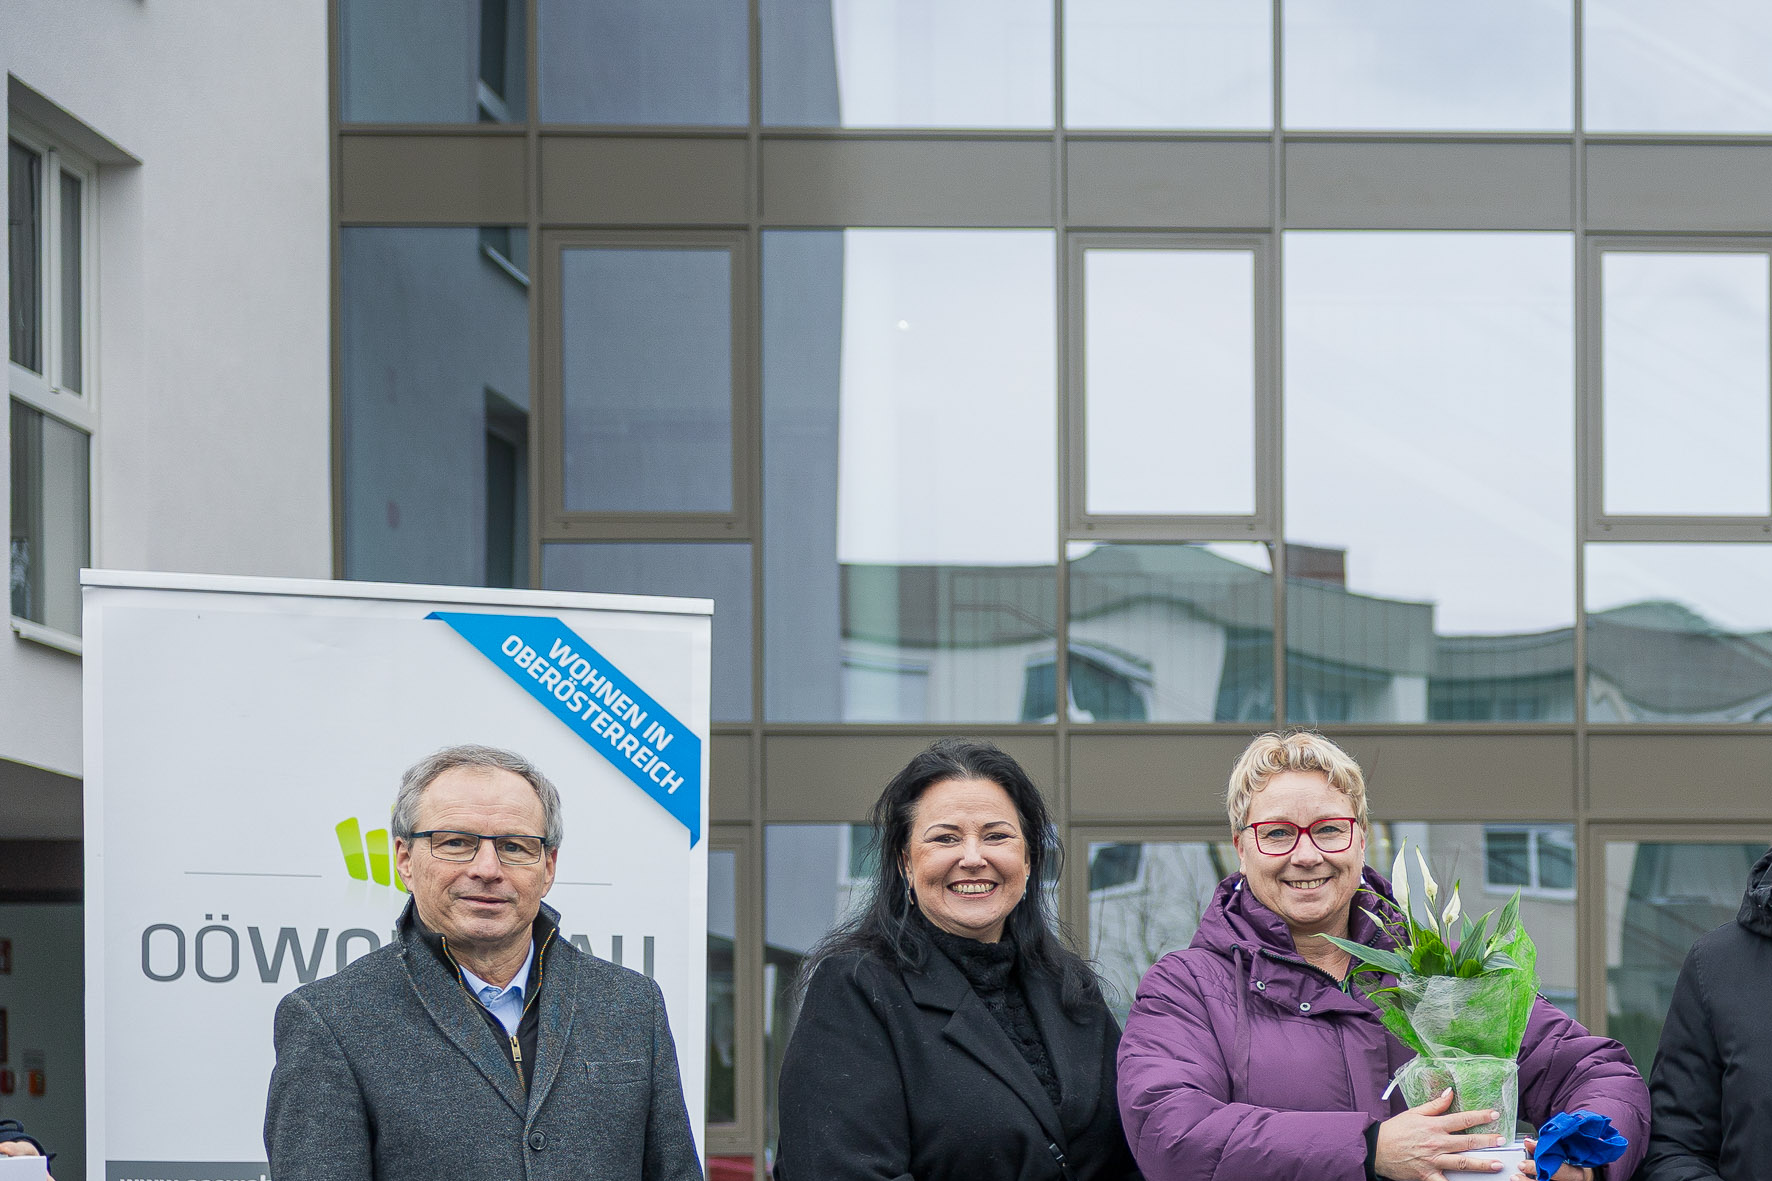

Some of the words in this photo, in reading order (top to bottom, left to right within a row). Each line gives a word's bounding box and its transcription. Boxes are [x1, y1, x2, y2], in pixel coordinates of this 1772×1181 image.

[501, 634, 685, 795] OBERÖSTERREICH
[548, 637, 648, 729] WOHNEN
[642, 721, 674, 751] IN
